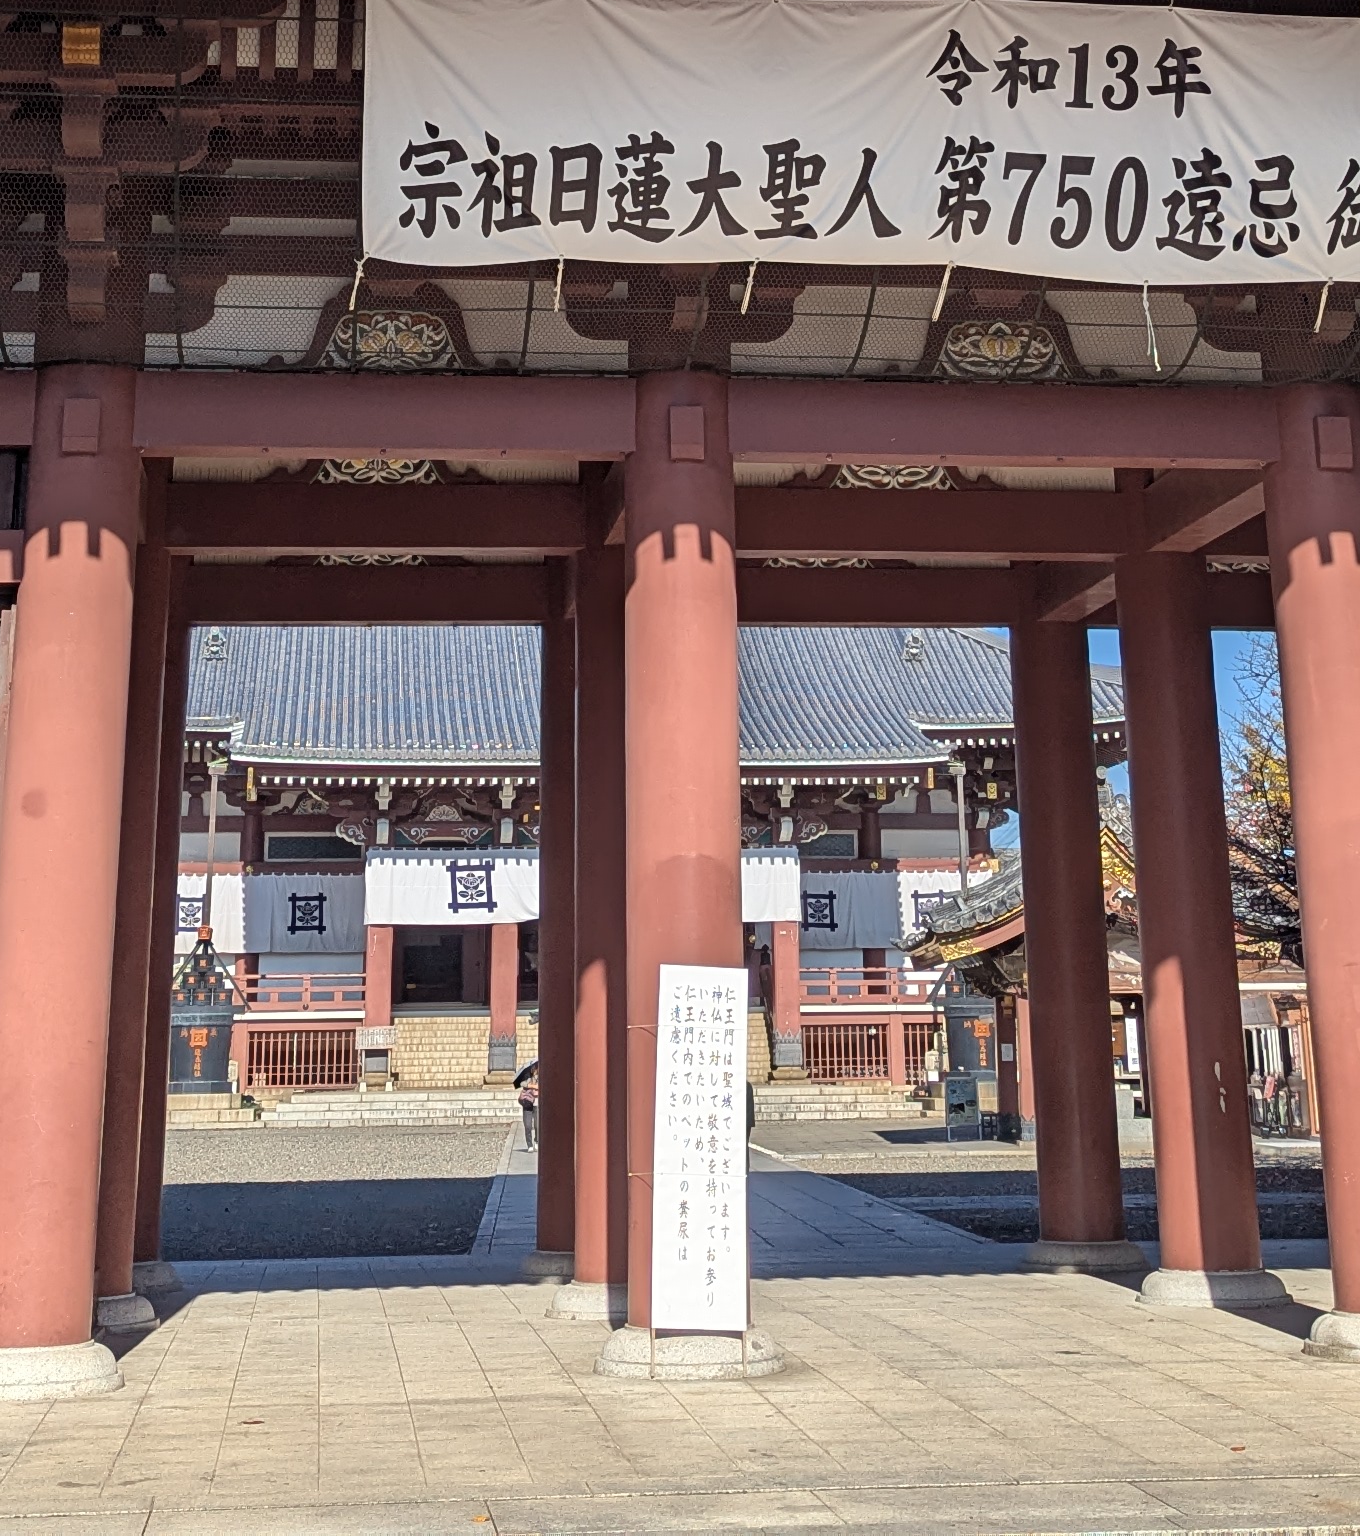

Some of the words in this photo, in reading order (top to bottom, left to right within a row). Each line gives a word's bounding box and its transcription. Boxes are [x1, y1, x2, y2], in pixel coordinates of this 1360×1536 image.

[926, 28, 1212, 119] 令和13年
[398, 120, 902, 244] 宗祖日蓮大聖人
[928, 135, 1301, 262] 第750遠忌
[677, 985, 697, 1262] 仁王門内でのペットの糞尿は
[694, 988, 709, 1164] いただきたいため、
[704, 985, 723, 1308] 神仏に対して敬意を持ってお参り
[720, 987, 737, 1253] 仁王門は聖域でございます。
